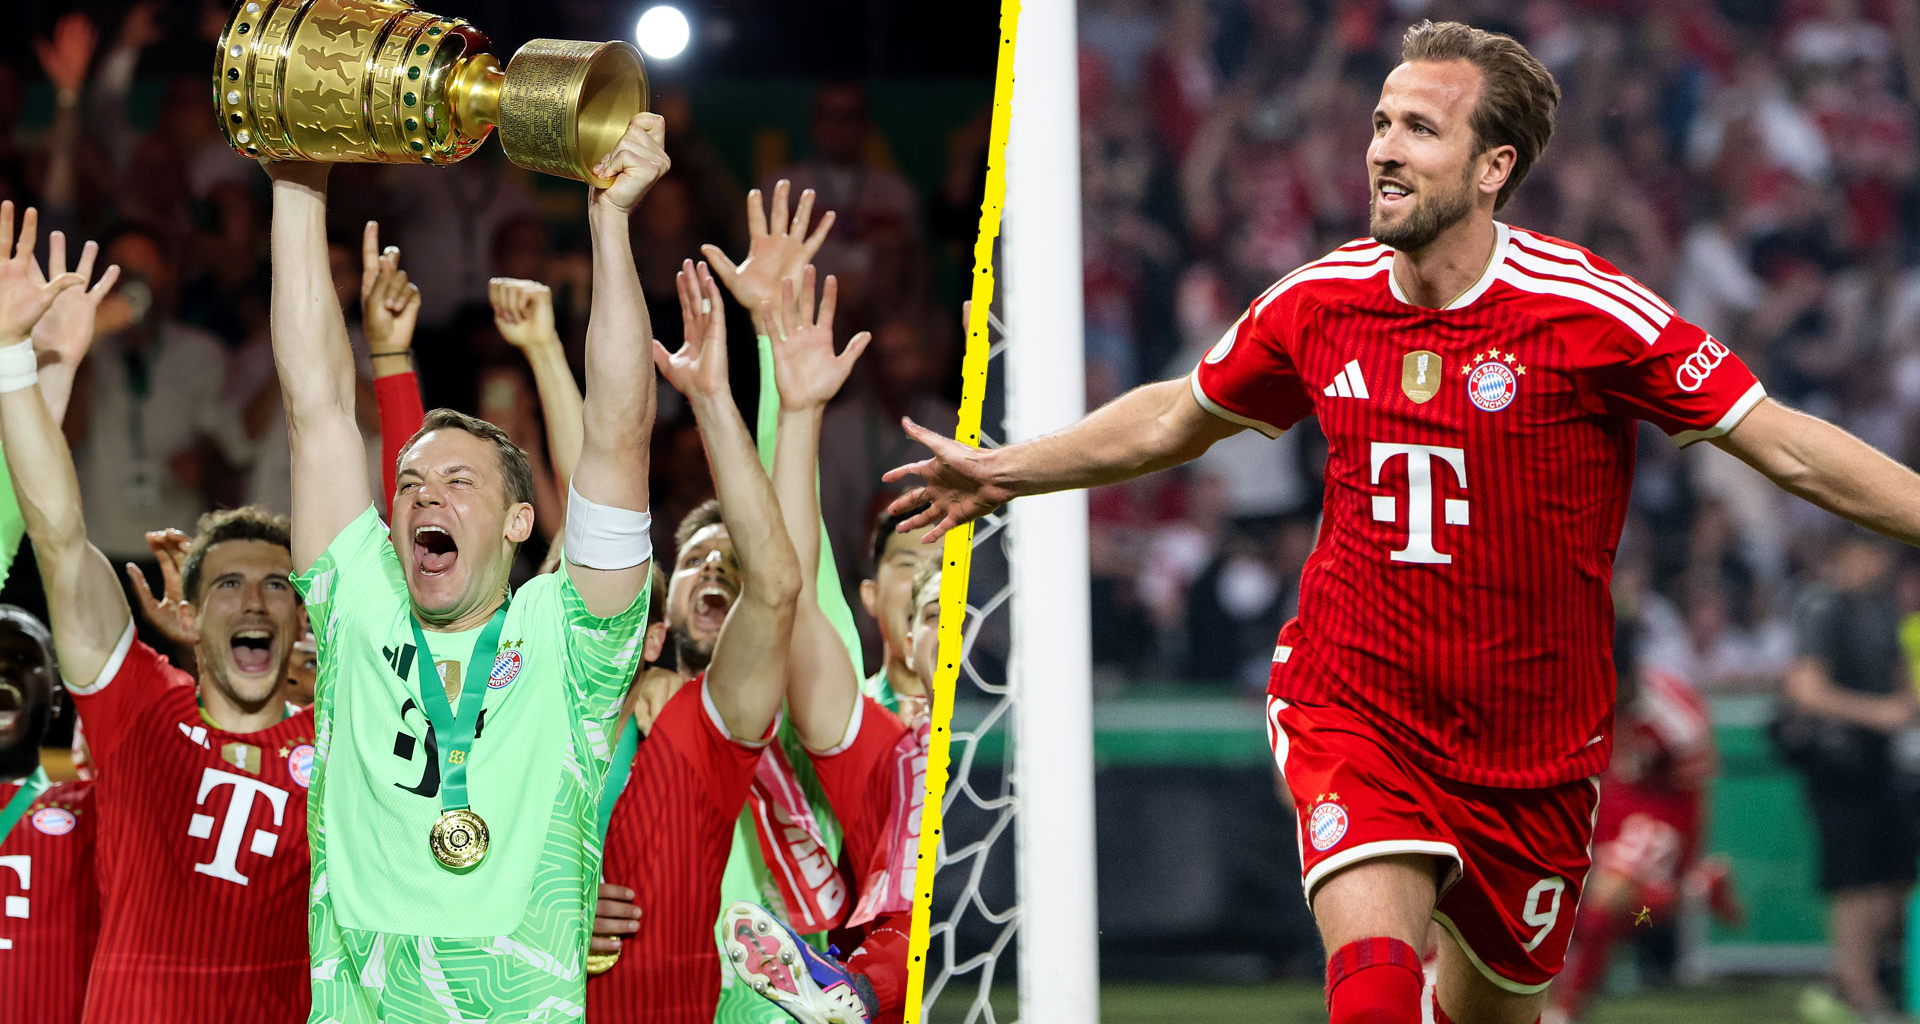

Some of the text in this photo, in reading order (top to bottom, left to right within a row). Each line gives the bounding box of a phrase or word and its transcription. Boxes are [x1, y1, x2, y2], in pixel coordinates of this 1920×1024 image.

[1472, 365, 1512, 384] FC BAYERN
[1371, 442, 1469, 564] T
[187, 767, 289, 886] T
[1521, 875, 1565, 953] 9
